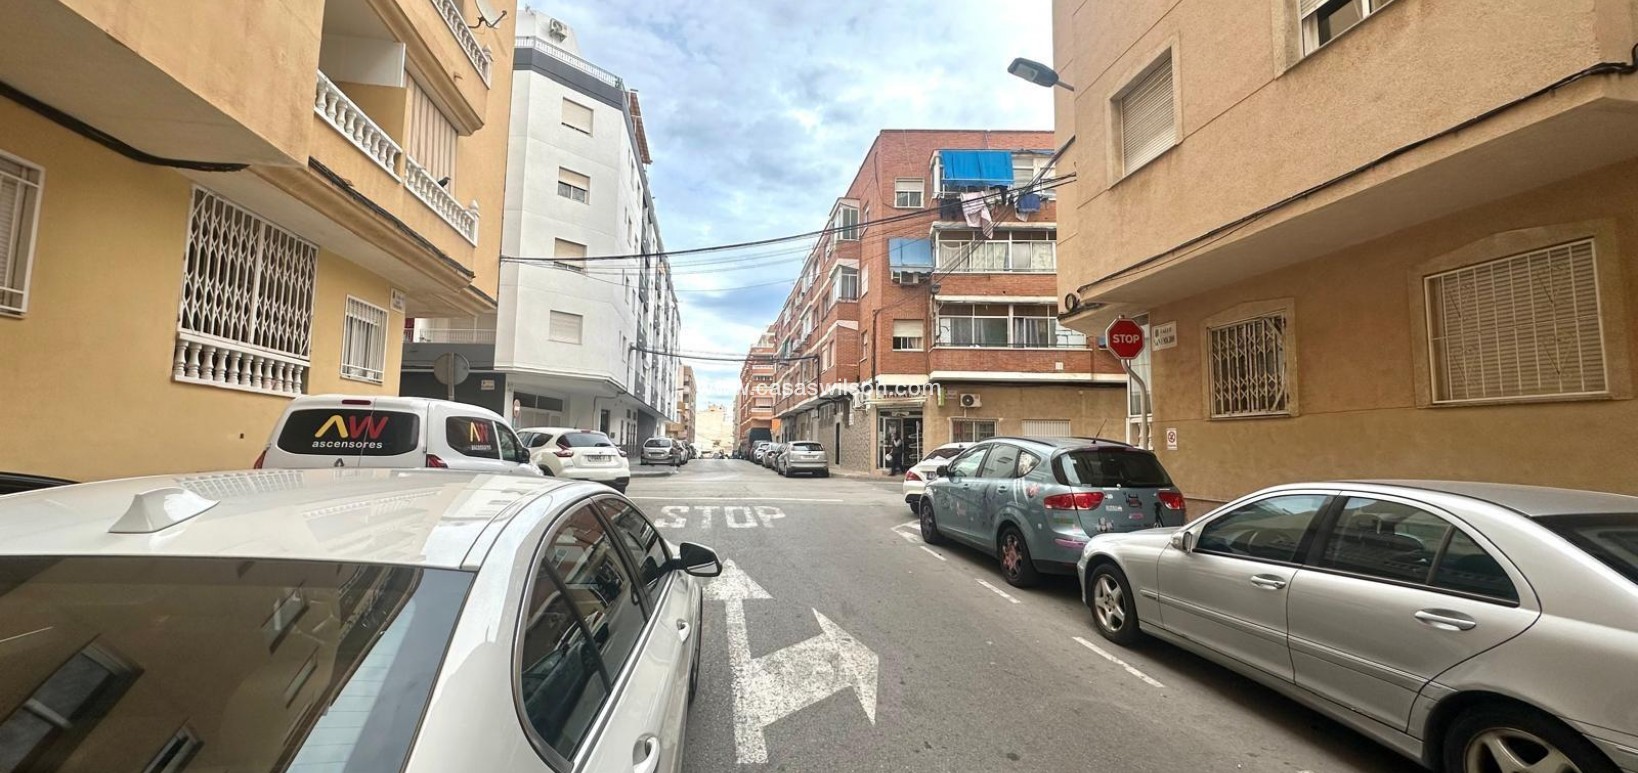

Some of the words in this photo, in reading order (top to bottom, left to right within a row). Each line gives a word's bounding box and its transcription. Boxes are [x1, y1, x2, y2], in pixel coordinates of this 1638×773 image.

[1113, 334, 1140, 344] STOP
[314, 414, 389, 439] AW
[312, 440, 383, 449] ascensores
[653, 505, 786, 528] STOP
